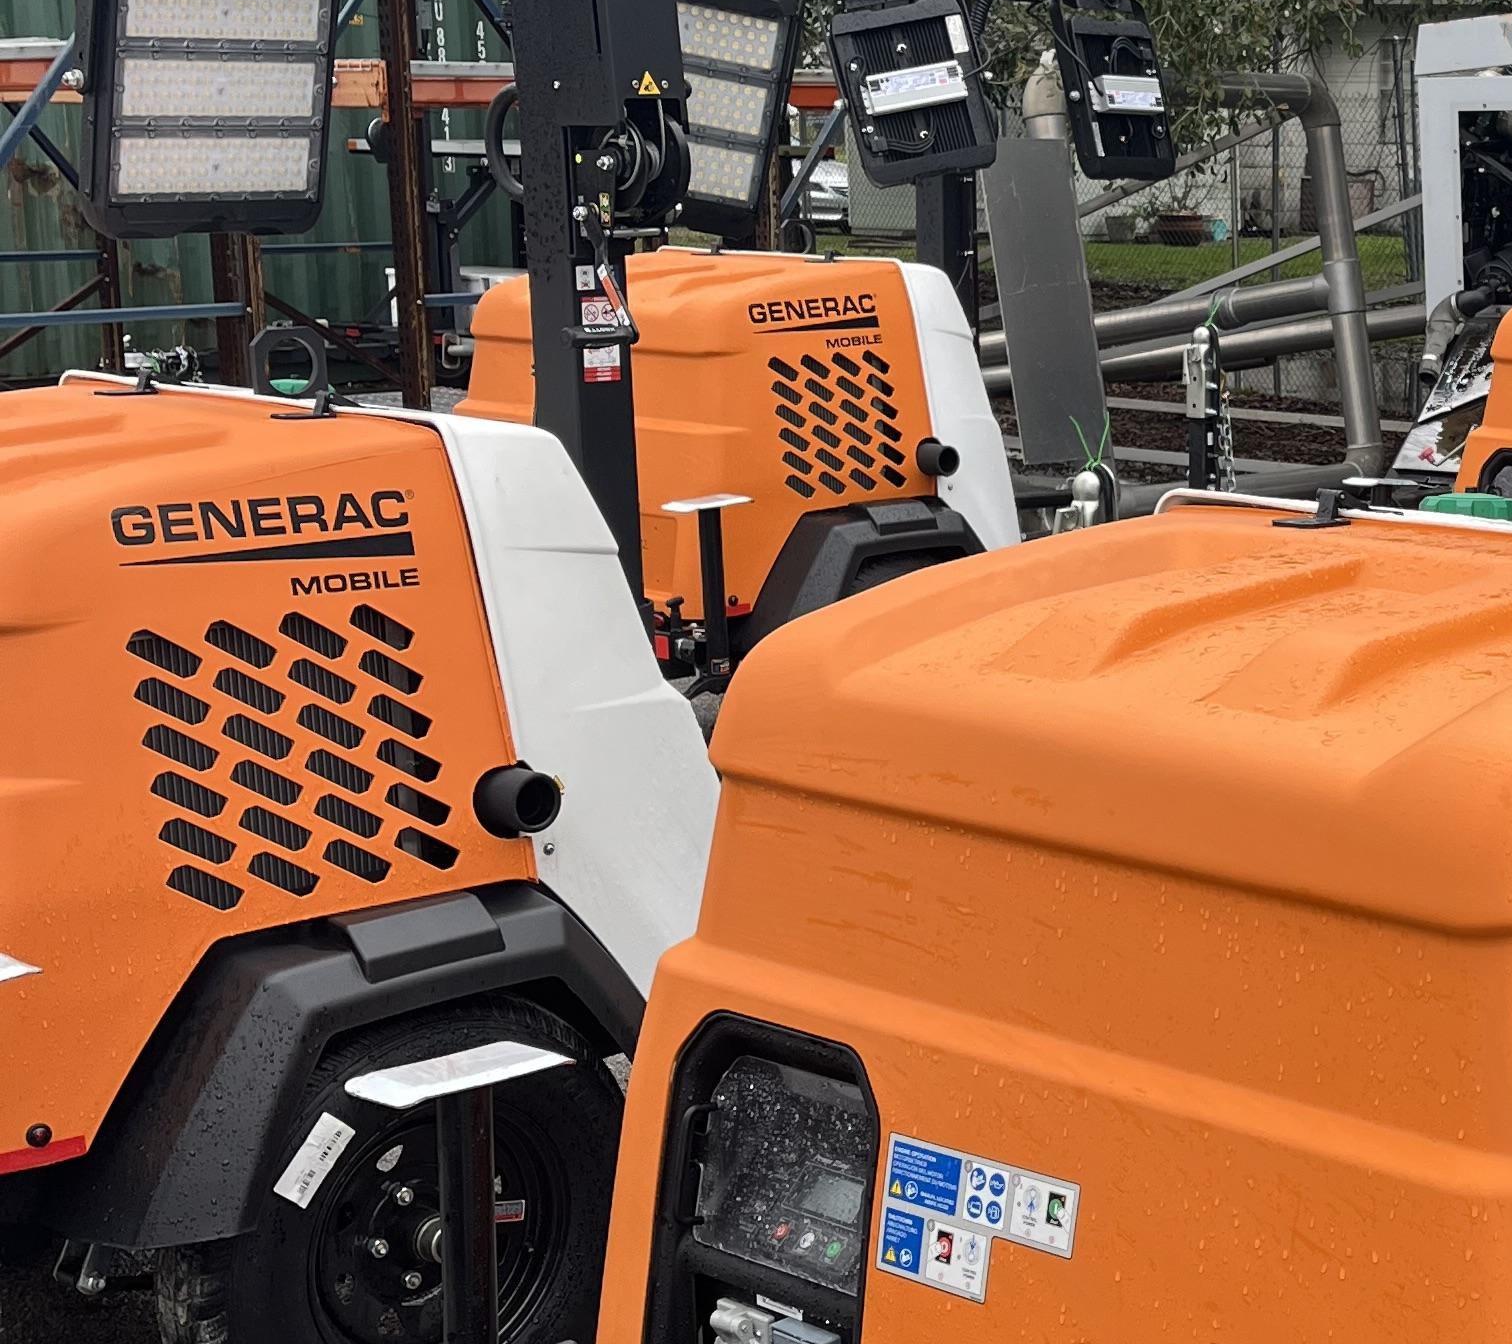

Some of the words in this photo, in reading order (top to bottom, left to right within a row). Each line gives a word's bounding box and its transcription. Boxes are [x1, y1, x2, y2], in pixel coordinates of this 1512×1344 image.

[748, 294, 876, 324] GENERAC
[826, 334, 883, 349] MOBILE
[111, 490, 410, 545] GENERAC
[290, 568, 420, 596] MOBILE
